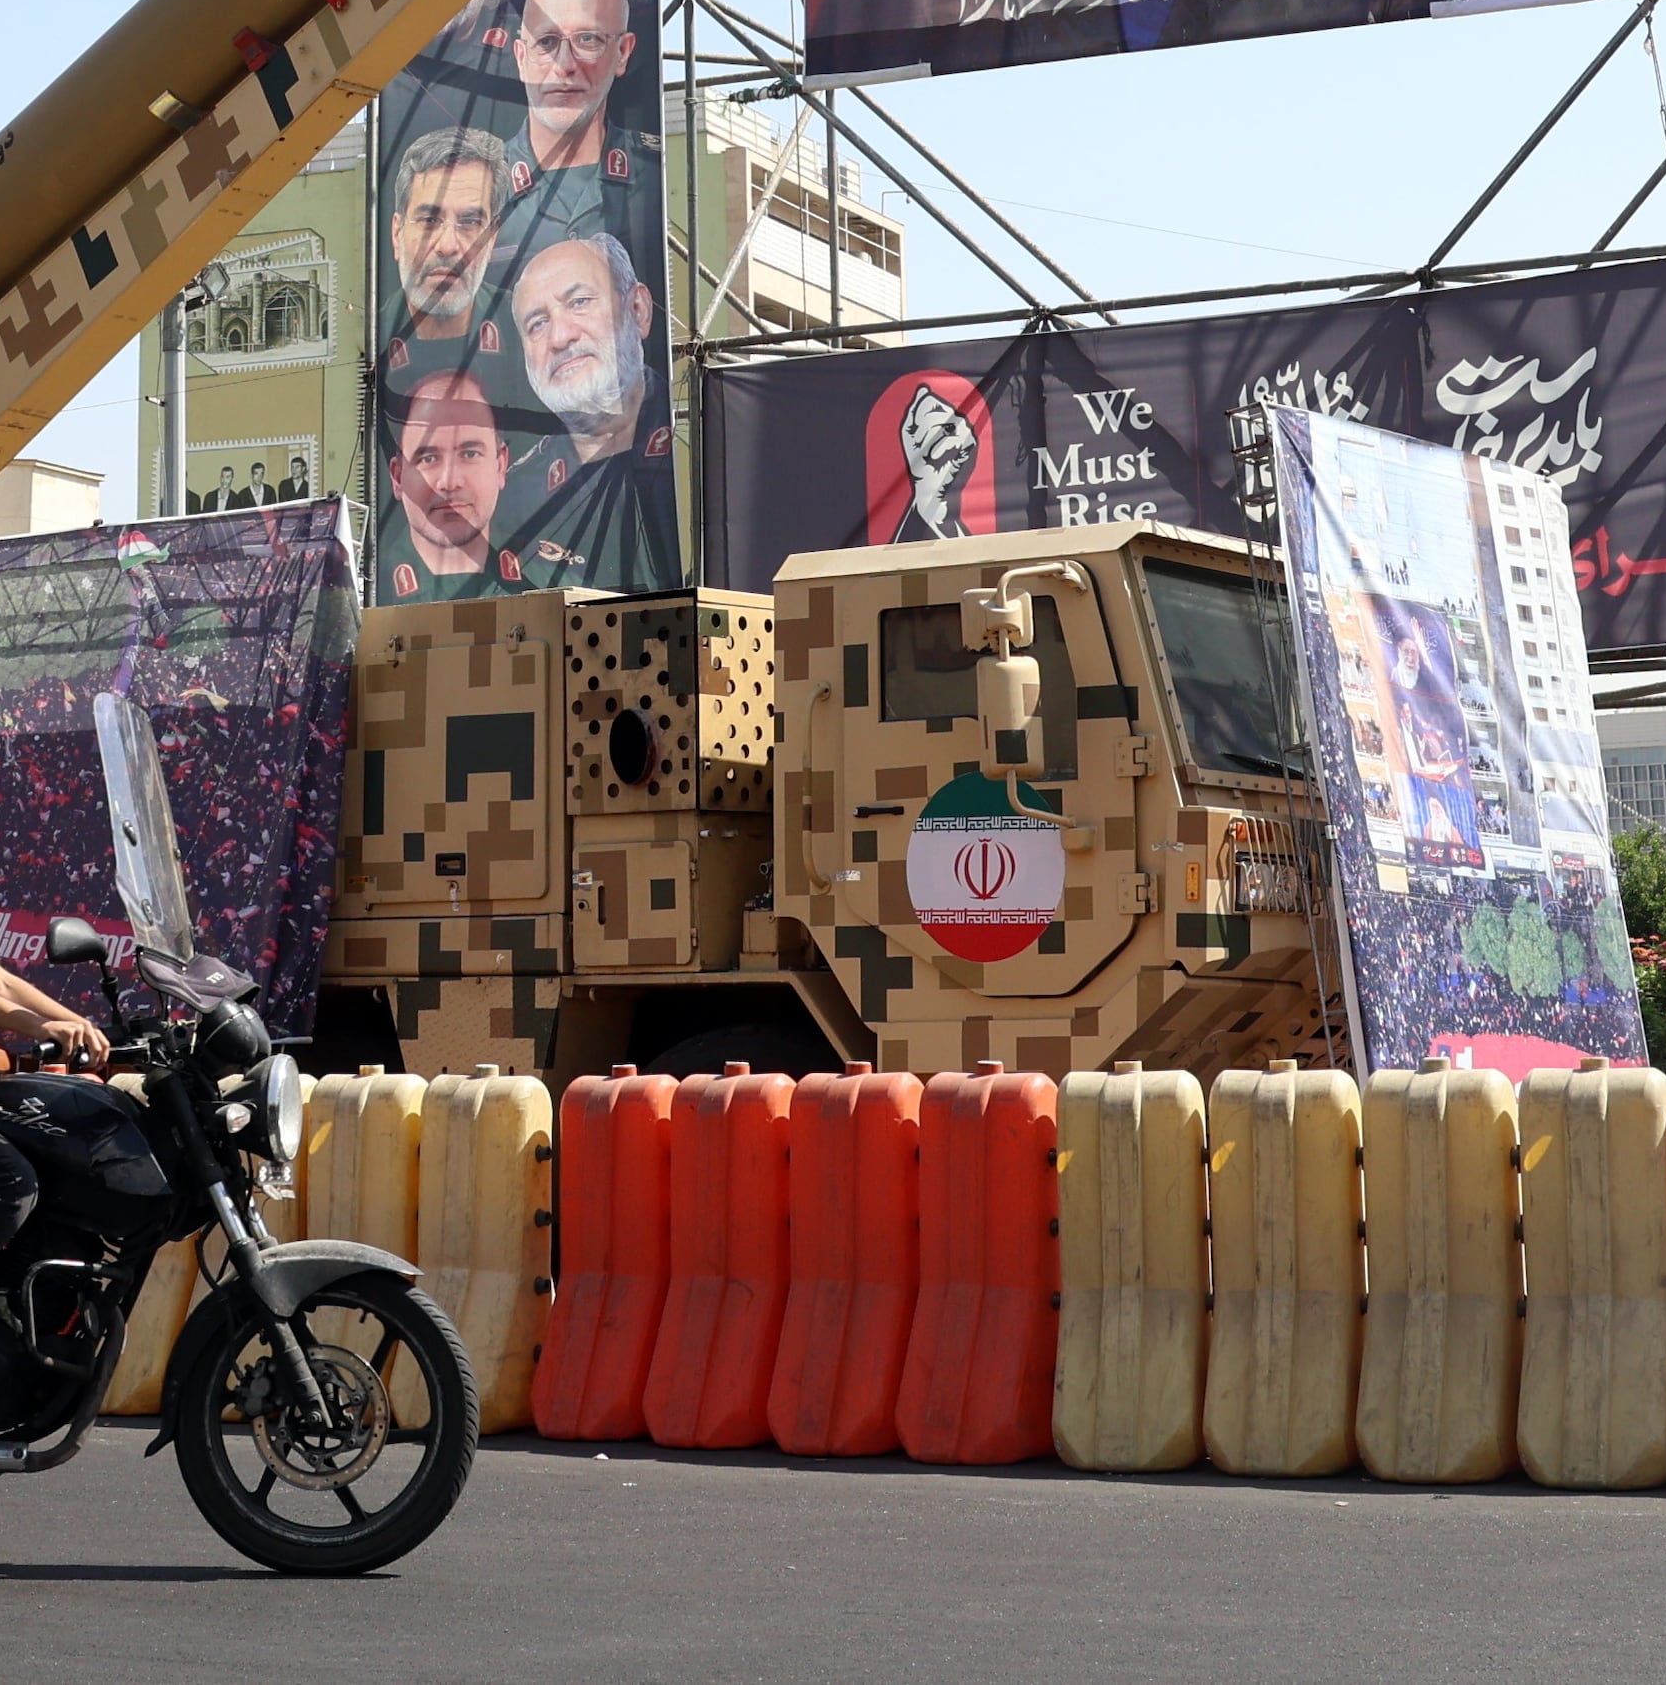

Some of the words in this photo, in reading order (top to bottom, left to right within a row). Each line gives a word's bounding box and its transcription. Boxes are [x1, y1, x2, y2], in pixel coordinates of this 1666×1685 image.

[1073, 388, 1154, 435] We
[1032, 443, 1158, 490] Must
[1056, 491, 1158, 528] Rise
